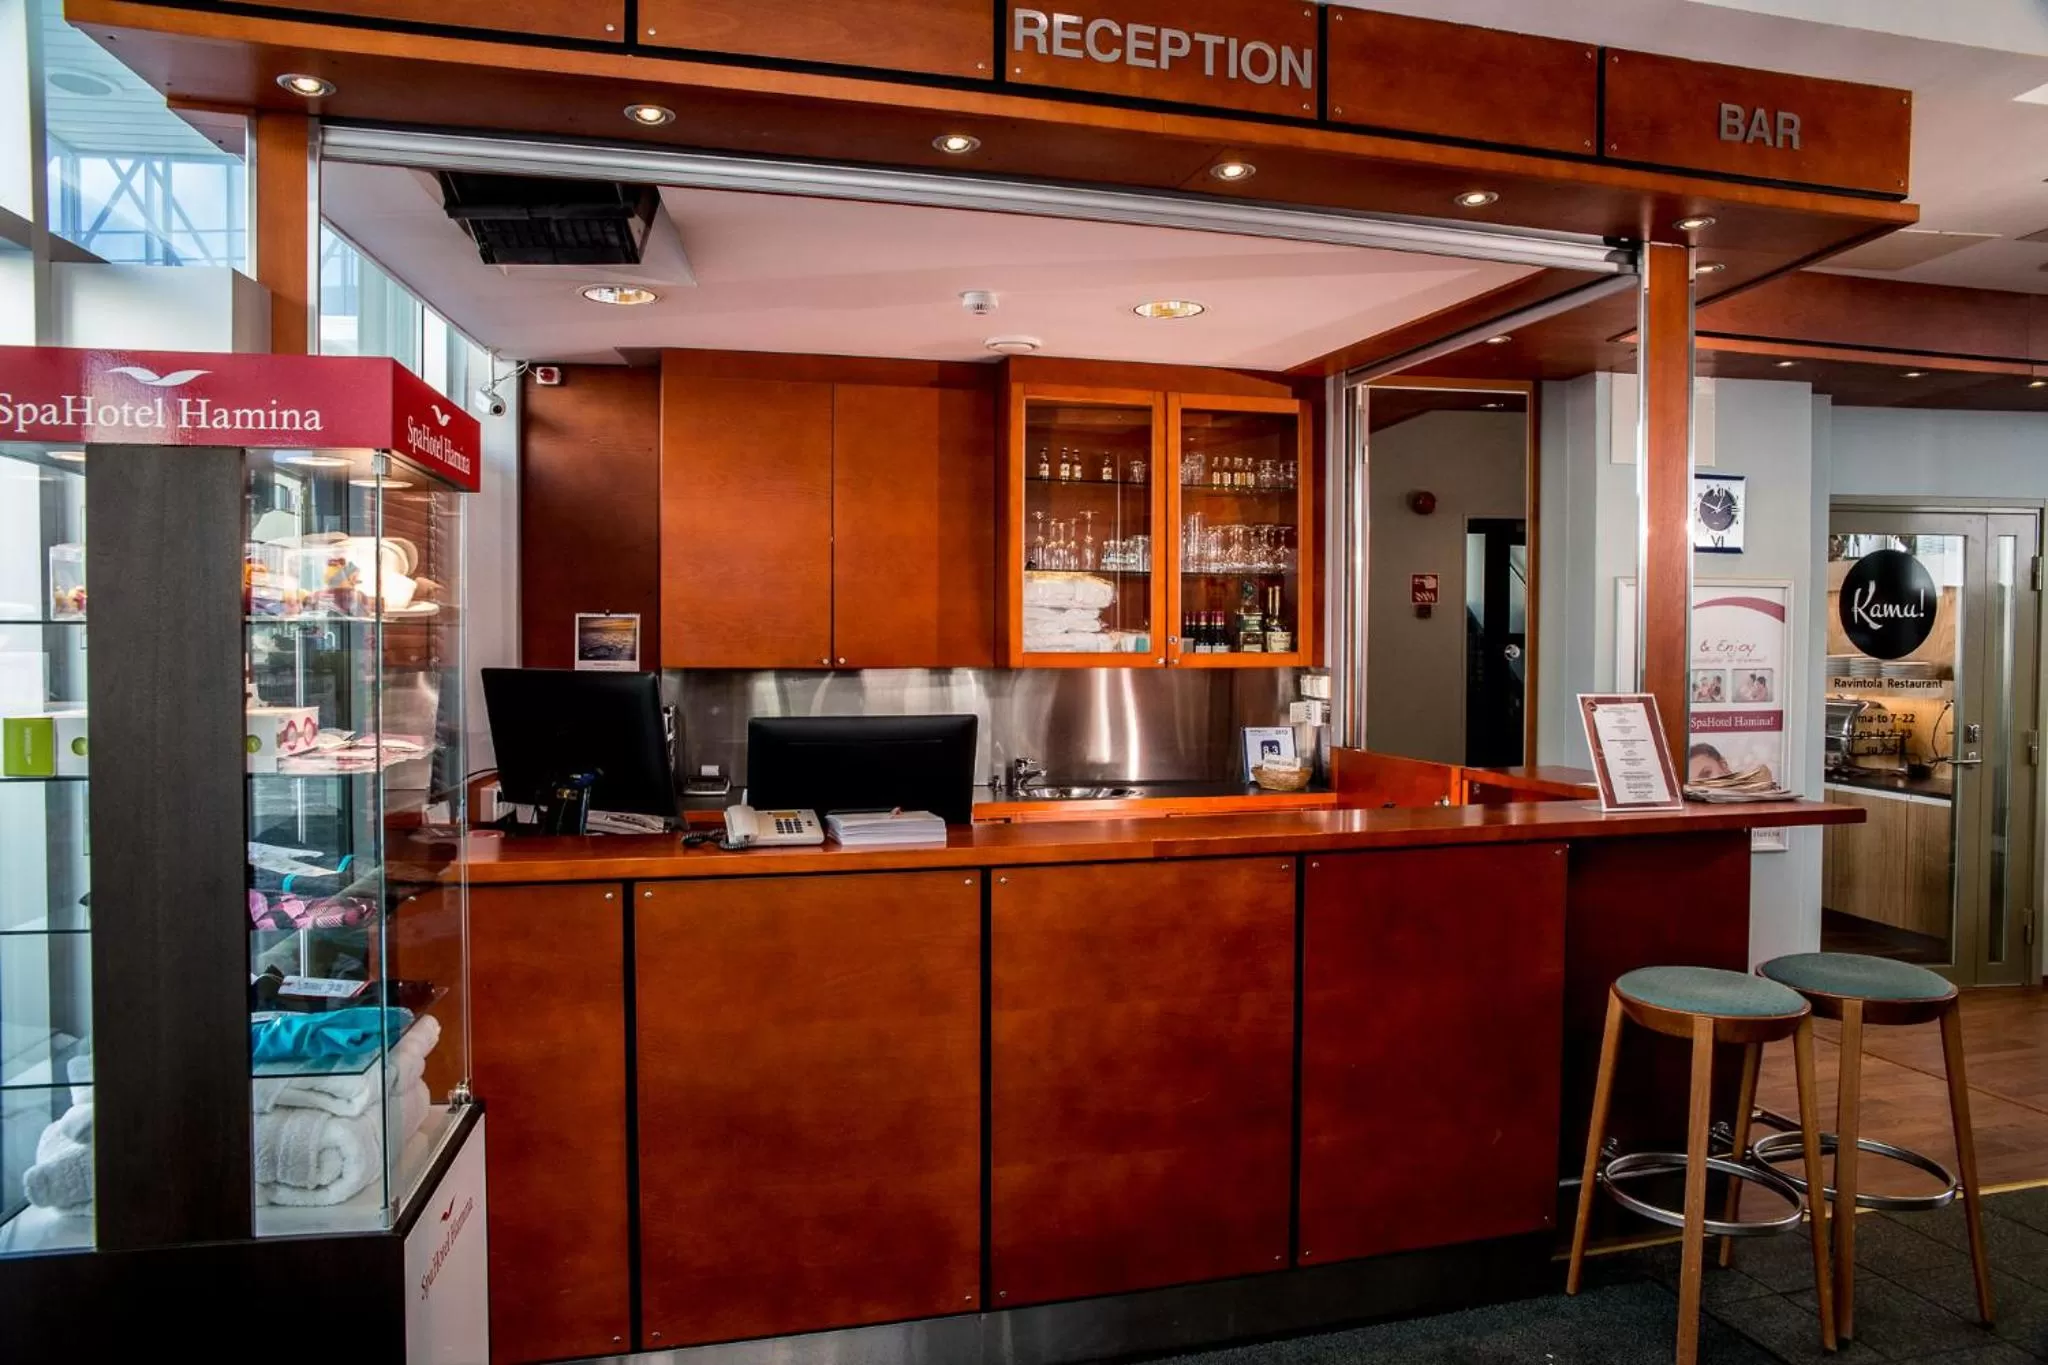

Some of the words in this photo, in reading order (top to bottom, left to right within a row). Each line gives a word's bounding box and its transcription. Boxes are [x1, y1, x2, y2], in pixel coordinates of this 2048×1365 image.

[1014, 8, 1312, 89] RECEPTION
[1719, 103, 1801, 150] BAR
[0, 393, 163, 432] SpaHotel
[178, 398, 323, 431] Hamina
[407, 414, 443, 454] SpaHotel
[443, 437, 471, 475] Hamina
[1851, 580, 1925, 630] Kamu!
[1717, 640, 1757, 657] Enjoy
[1834, 678, 1882, 689] Ravintola
[1887, 679, 1944, 689] Restaurant
[1691, 716, 1732, 730] SpaHotel
[1734, 715, 1775, 728] Hamina!
